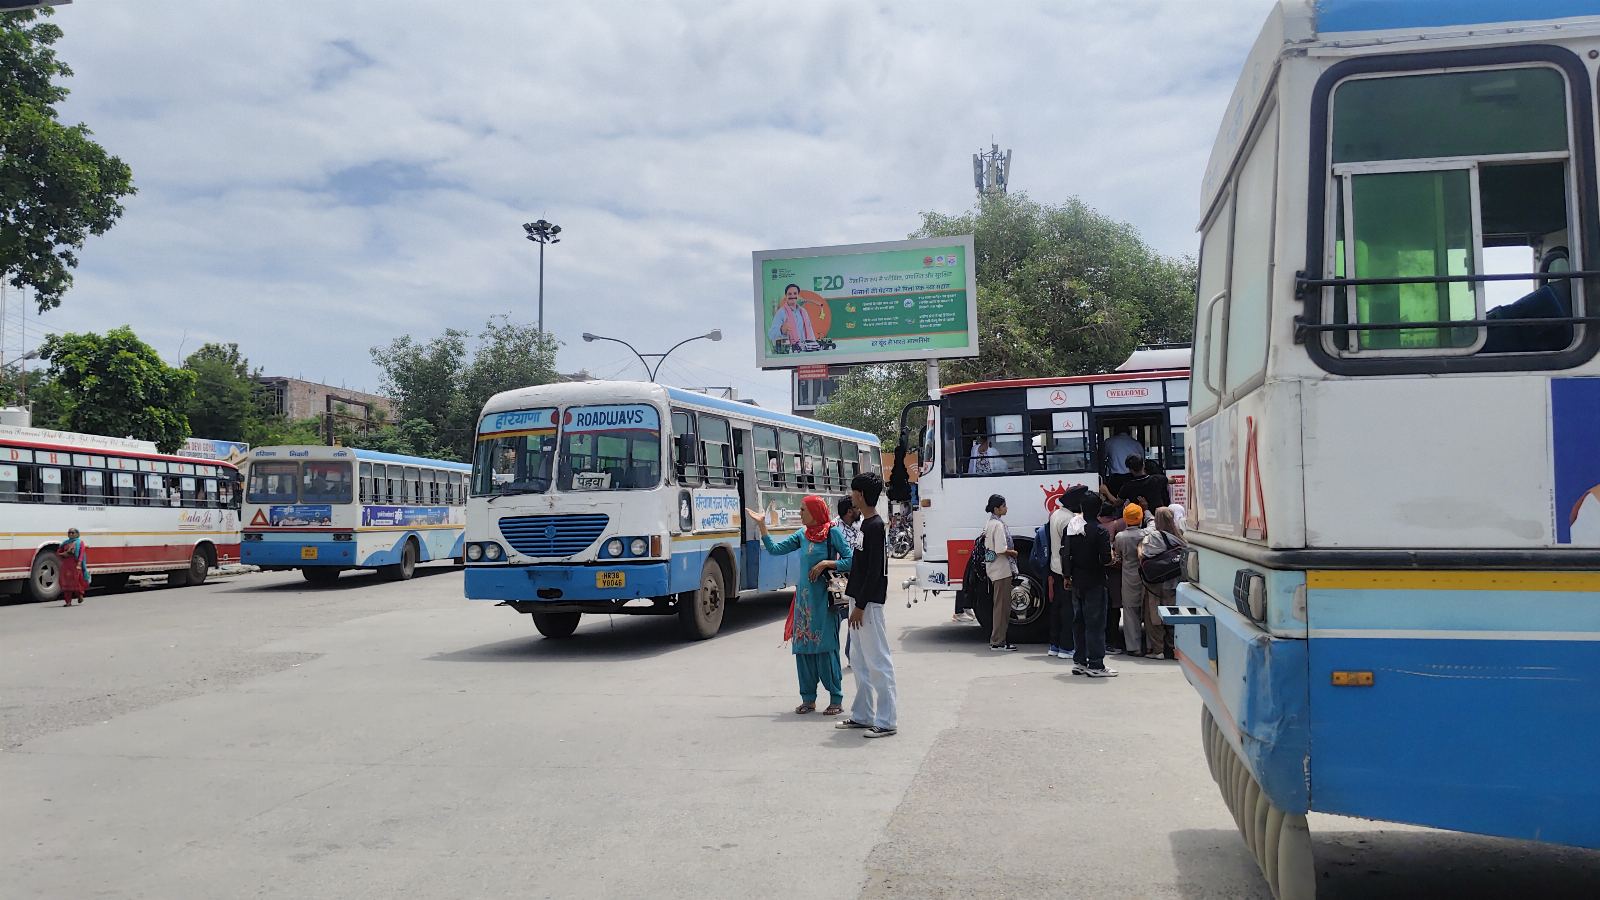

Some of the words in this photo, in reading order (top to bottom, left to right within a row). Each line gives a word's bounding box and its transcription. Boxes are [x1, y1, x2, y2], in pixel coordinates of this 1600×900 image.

[813, 275, 845, 292] E20
[1110, 388, 1145, 397] WELCOME
[495, 411, 542, 429] हरियाणा
[576, 409, 644, 427] ROADWAYS
